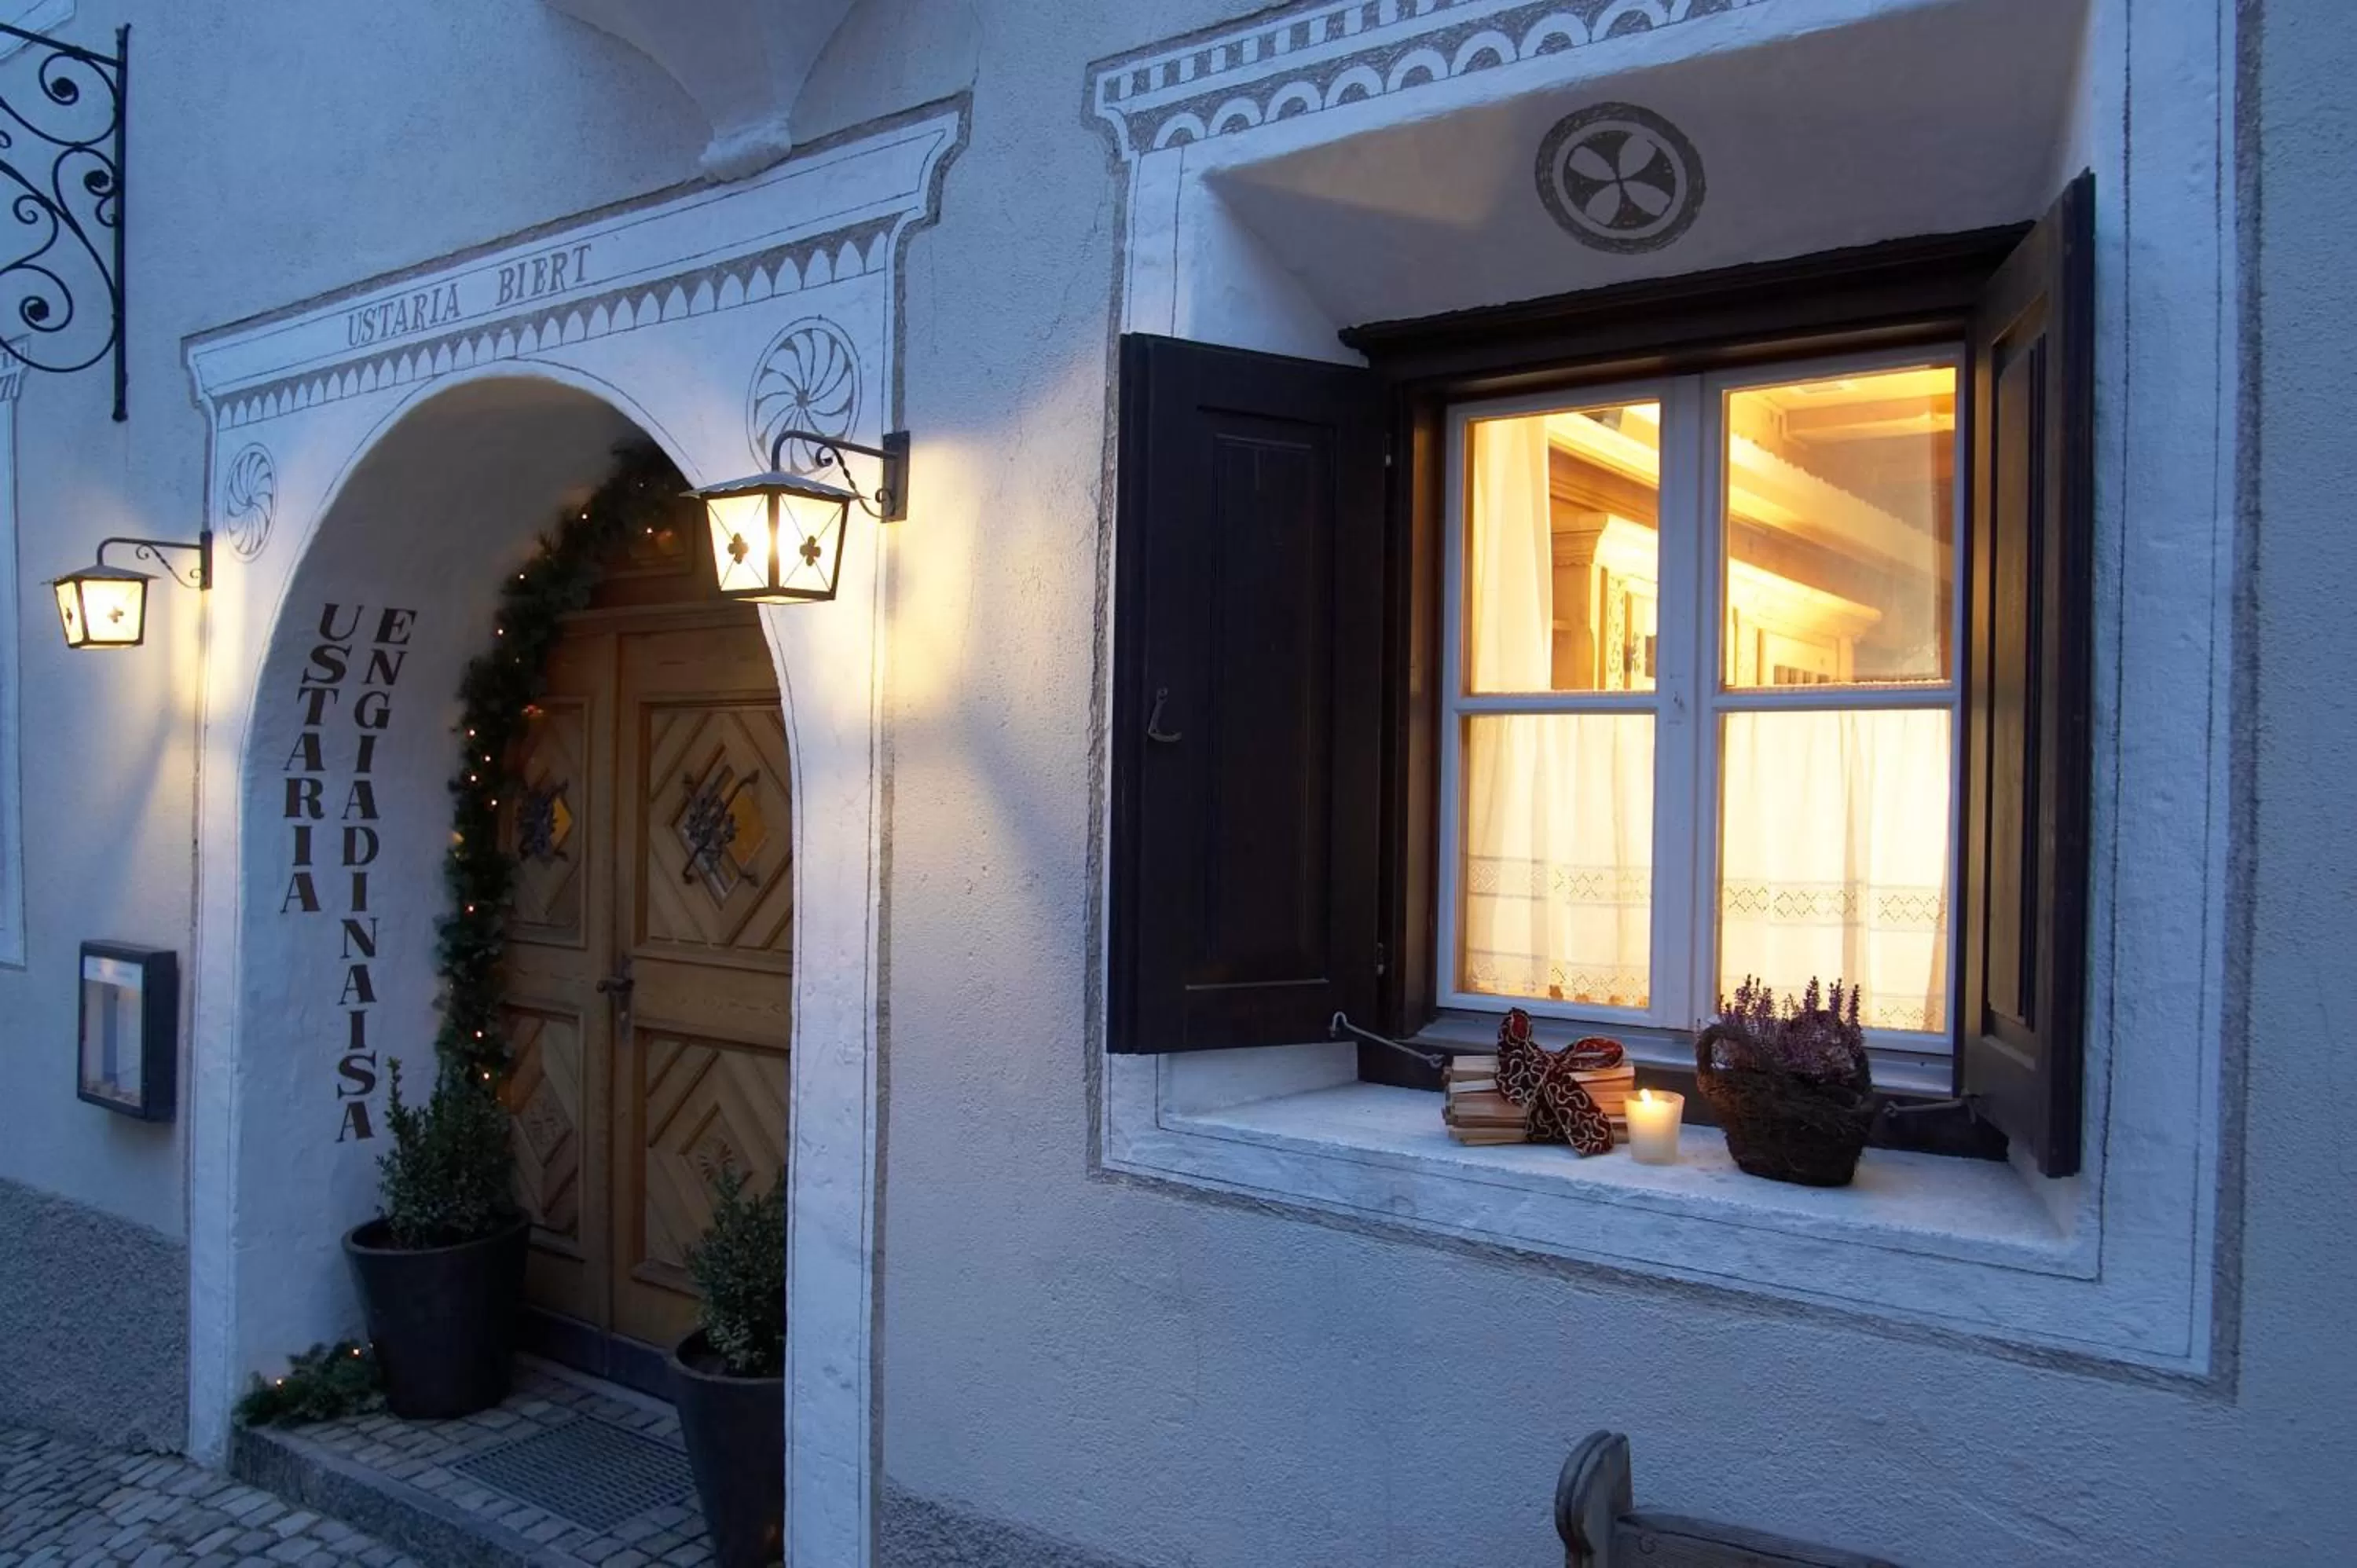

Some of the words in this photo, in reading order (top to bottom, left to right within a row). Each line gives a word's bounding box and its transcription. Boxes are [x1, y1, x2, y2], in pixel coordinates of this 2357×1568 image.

[347, 283, 462, 346] USTARIA
[497, 244, 591, 306] BIERT
[279, 603, 365, 914] USTARIA
[335, 608, 417, 1143] ENGIADINAISA
